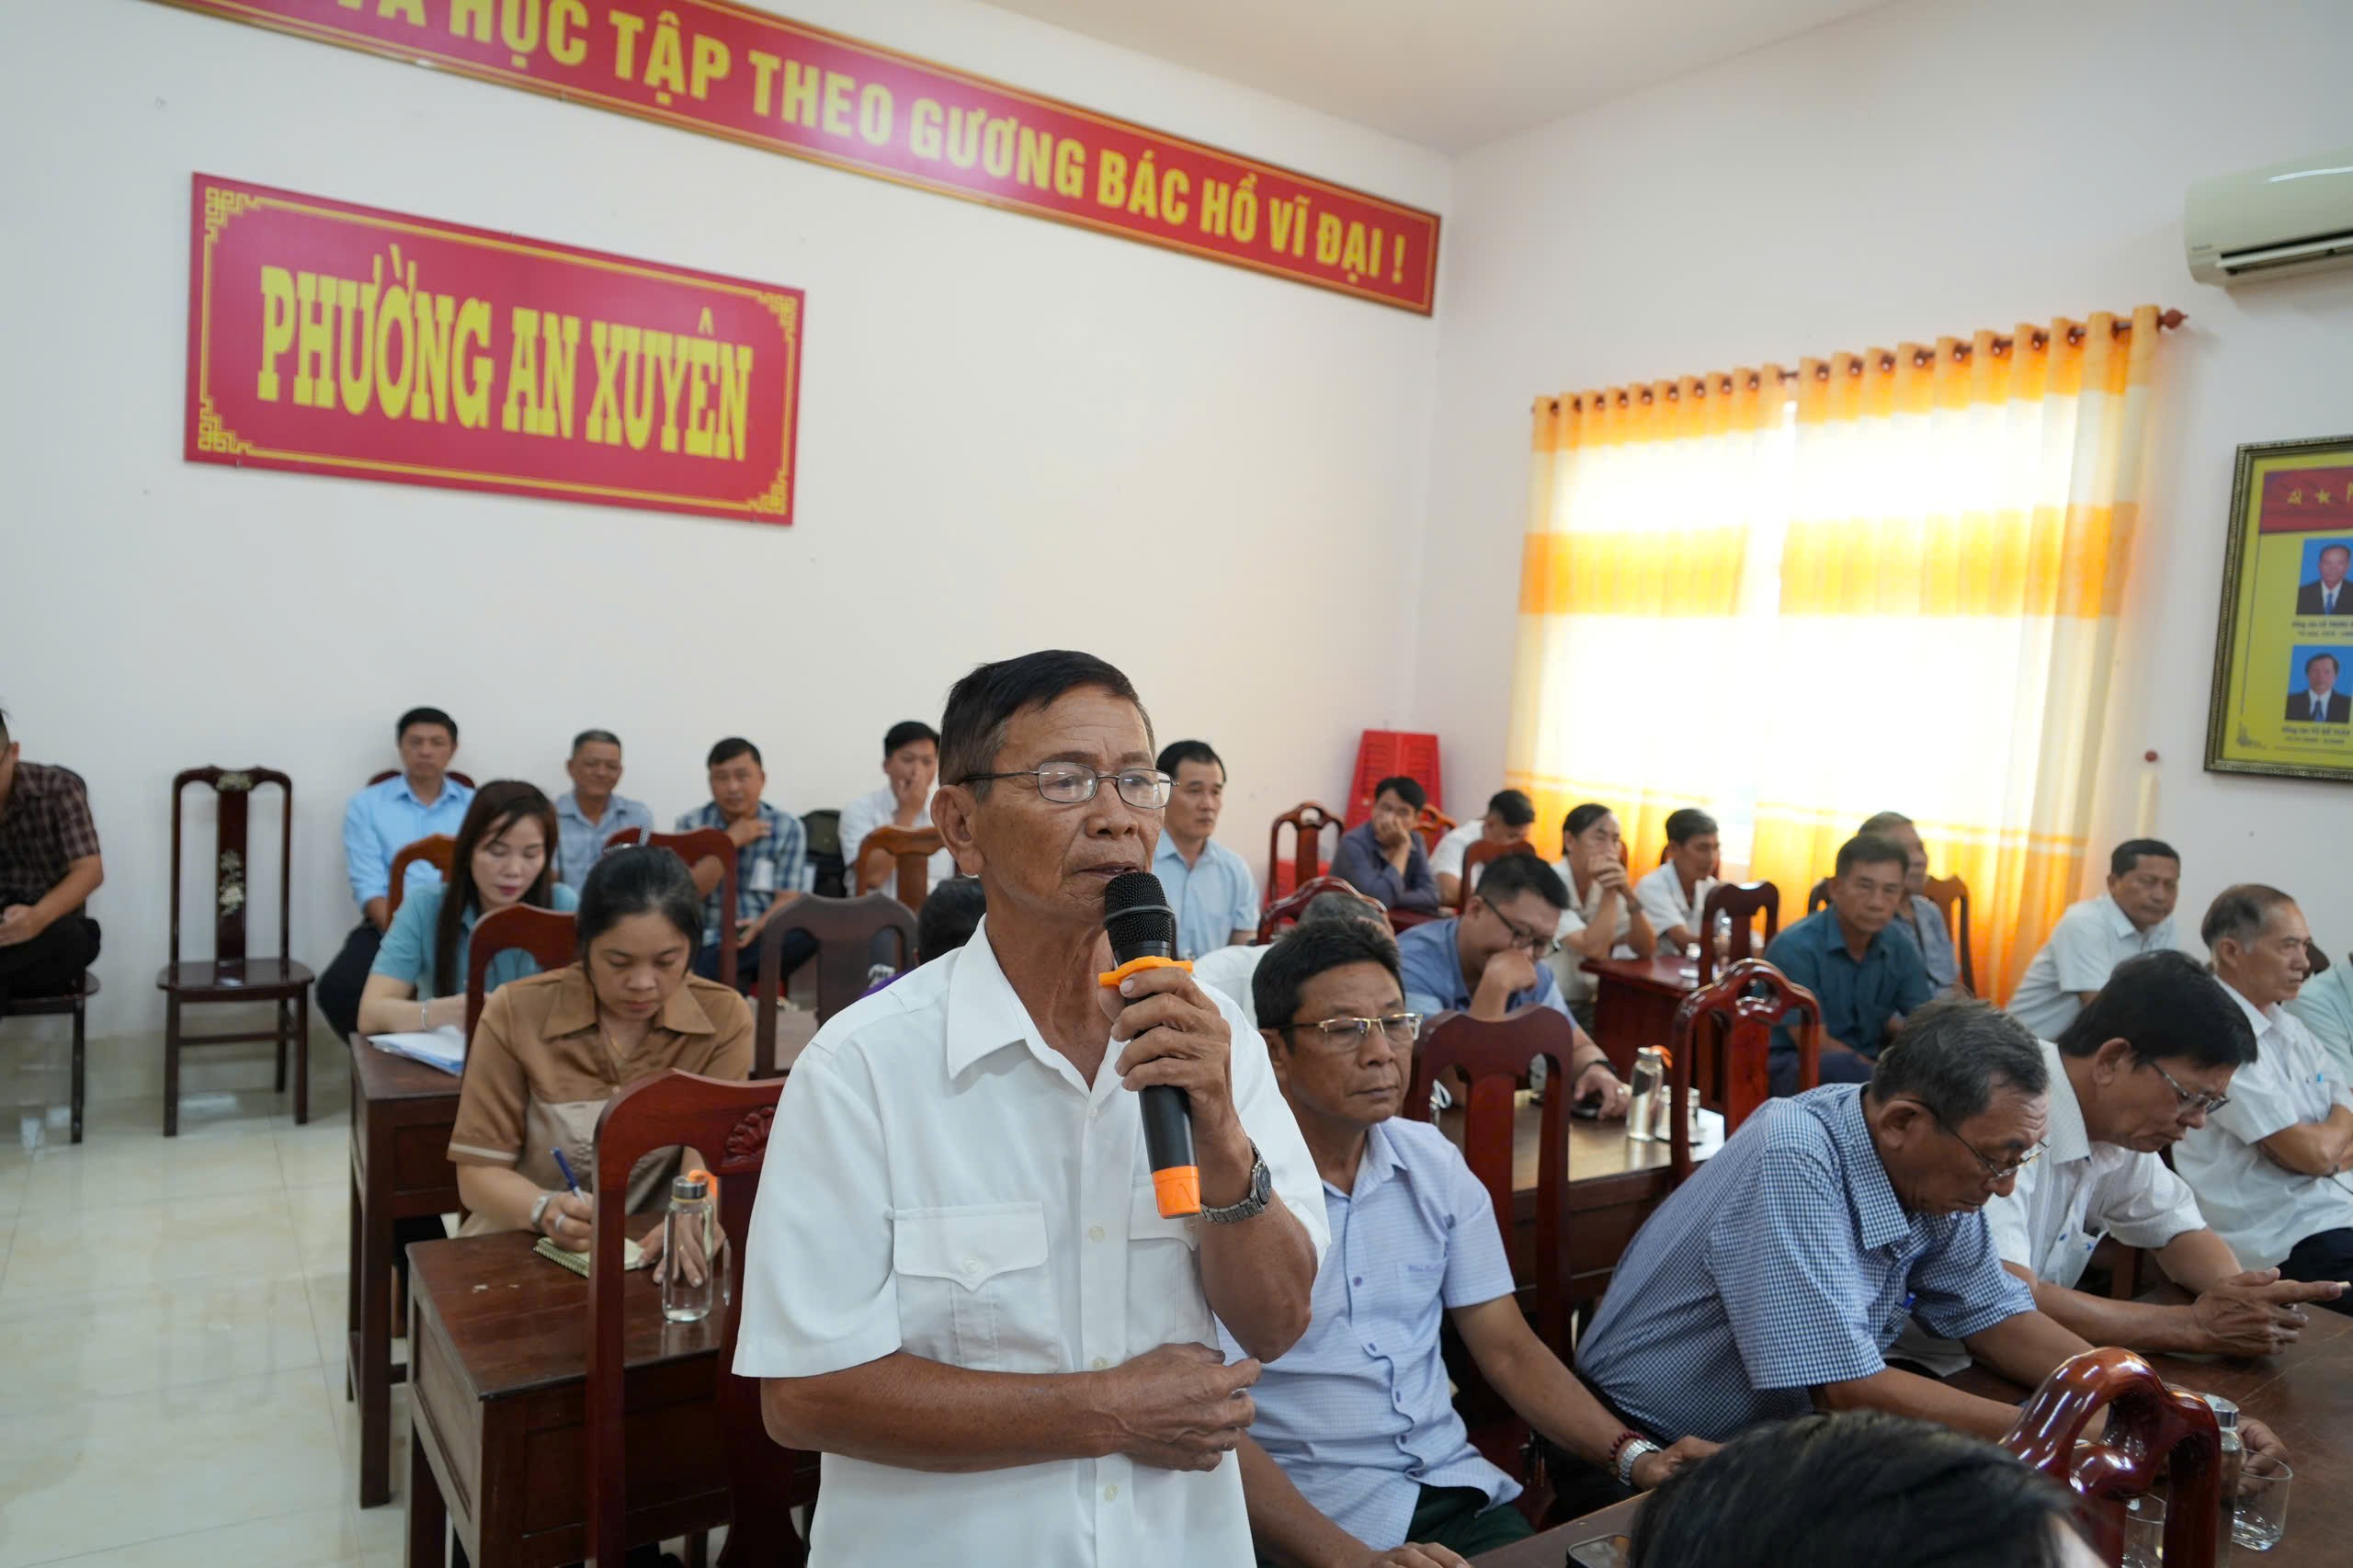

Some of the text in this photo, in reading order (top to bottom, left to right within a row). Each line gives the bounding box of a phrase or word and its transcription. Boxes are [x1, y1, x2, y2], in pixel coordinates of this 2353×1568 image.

[449, 0, 1406, 284] HỌC TẬP THEO GƯƠNG BÁC HỒ VĨ ĐẠI !
[256, 244, 755, 461] PHƯỜNG AN XUYÊN
